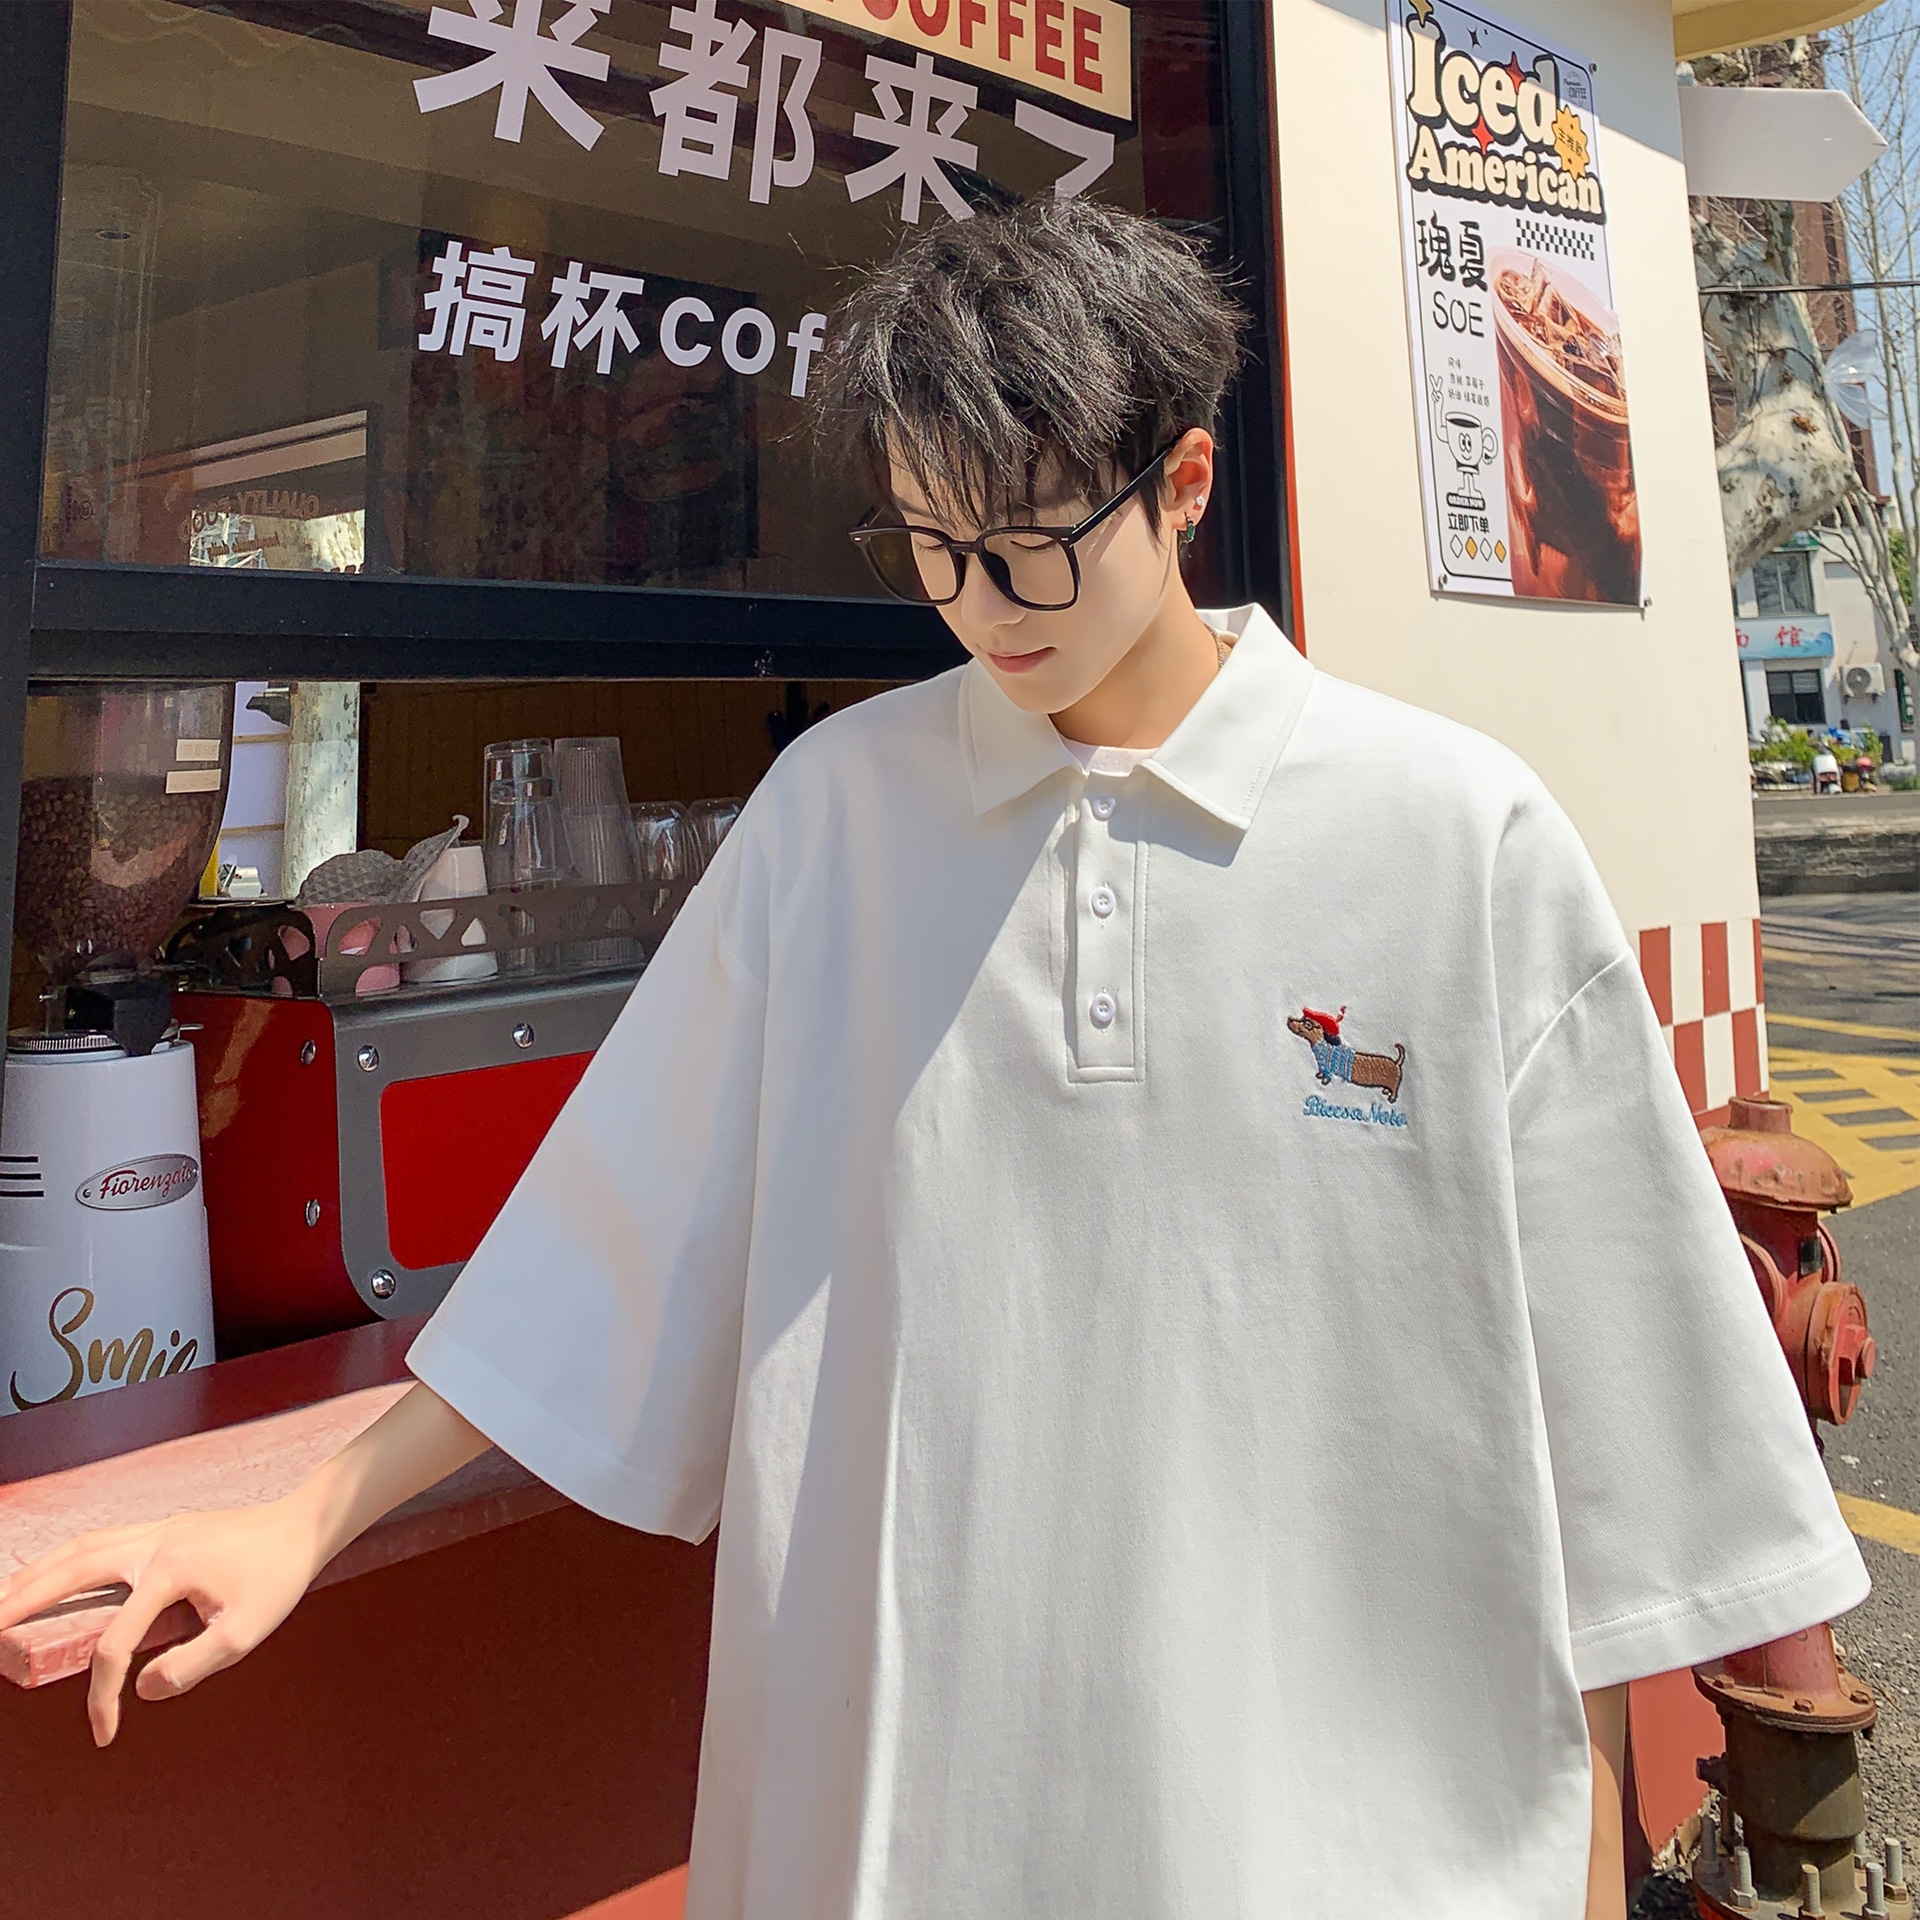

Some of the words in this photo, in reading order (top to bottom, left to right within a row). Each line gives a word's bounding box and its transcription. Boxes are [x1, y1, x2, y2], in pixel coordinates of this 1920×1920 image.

[1407, 14, 1560, 156] Iced
[1407, 124, 1605, 223] American
[1416, 209, 1488, 292] 瑰夏
[1433, 291, 1485, 338] SOE
[1447, 512, 1490, 534] 立即下单
